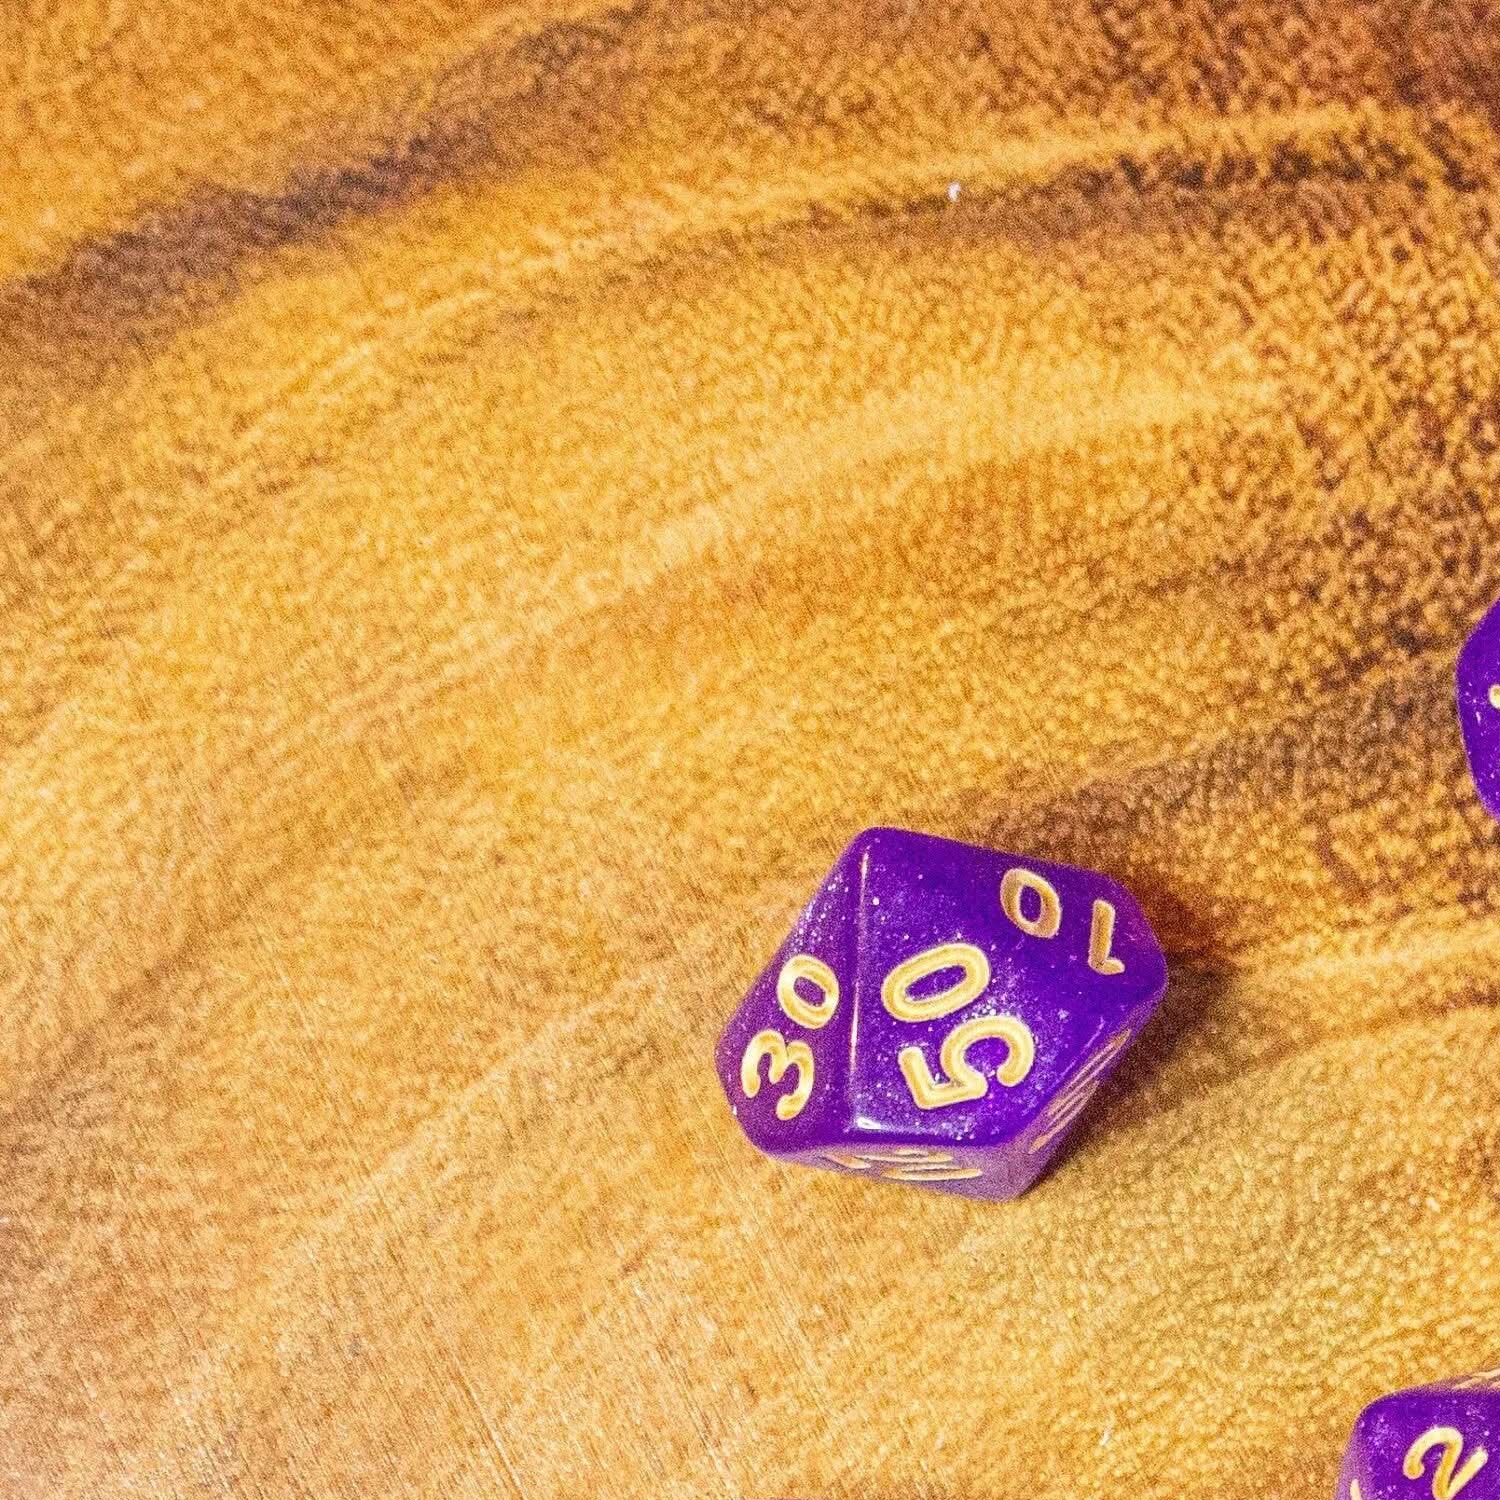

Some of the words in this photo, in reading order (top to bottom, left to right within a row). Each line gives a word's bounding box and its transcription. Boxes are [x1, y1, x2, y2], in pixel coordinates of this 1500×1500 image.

[1001, 868, 1125, 975] 10
[741, 955, 839, 1120] 30
[881, 943, 1035, 1110] 50
